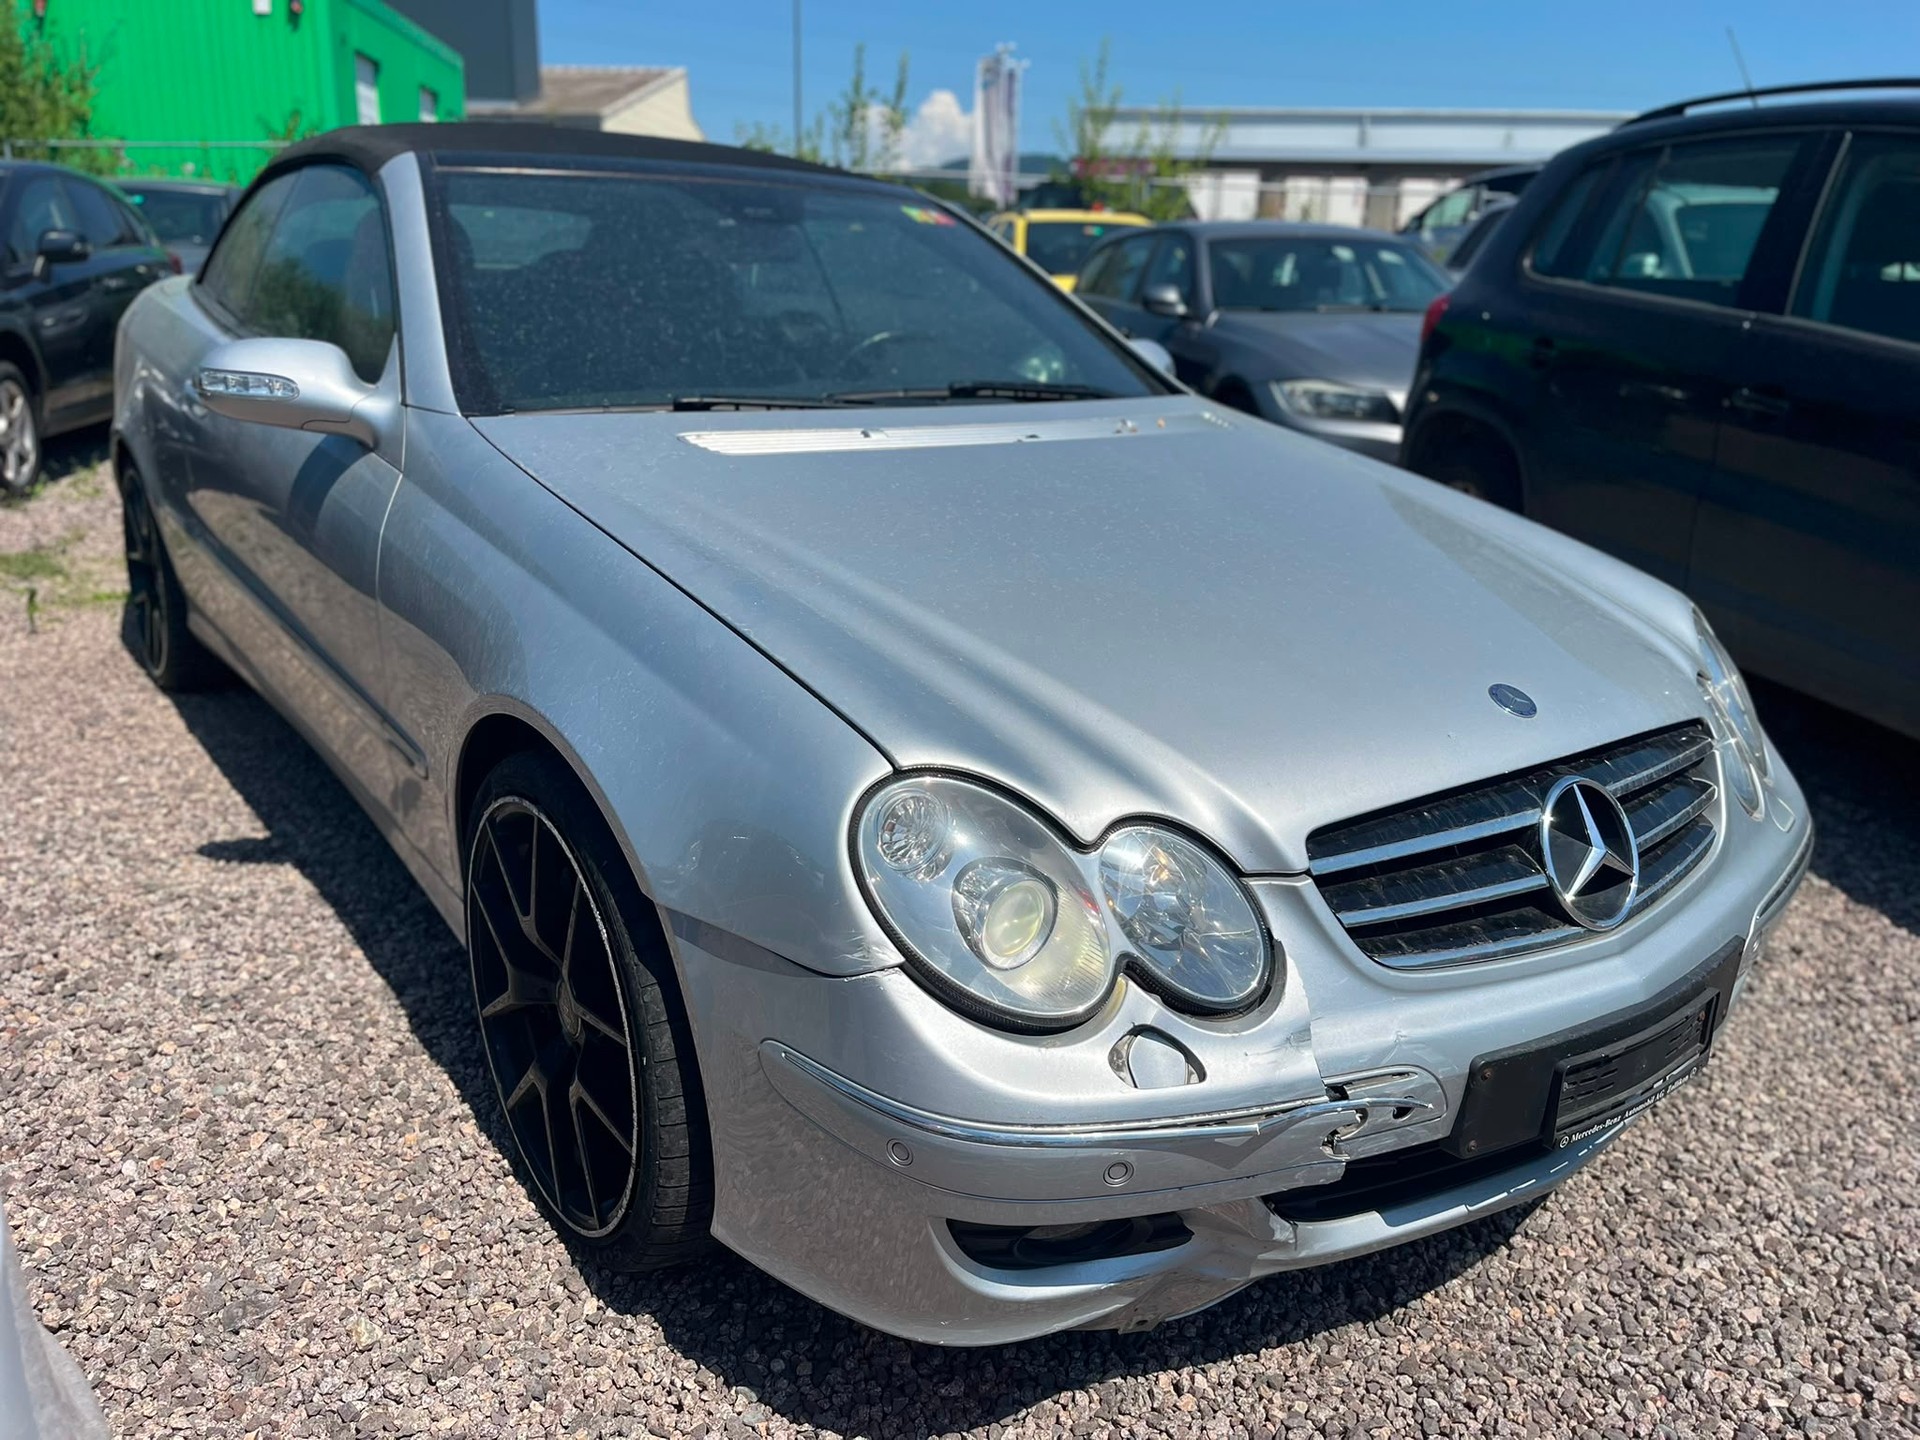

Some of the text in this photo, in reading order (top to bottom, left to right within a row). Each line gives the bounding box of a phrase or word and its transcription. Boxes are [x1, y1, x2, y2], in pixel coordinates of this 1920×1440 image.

[1570, 1115, 1622, 1143] Mercedes-Benz
[1623, 1095, 1655, 1118] Automobil
[1655, 1089, 1665, 1101] AG
